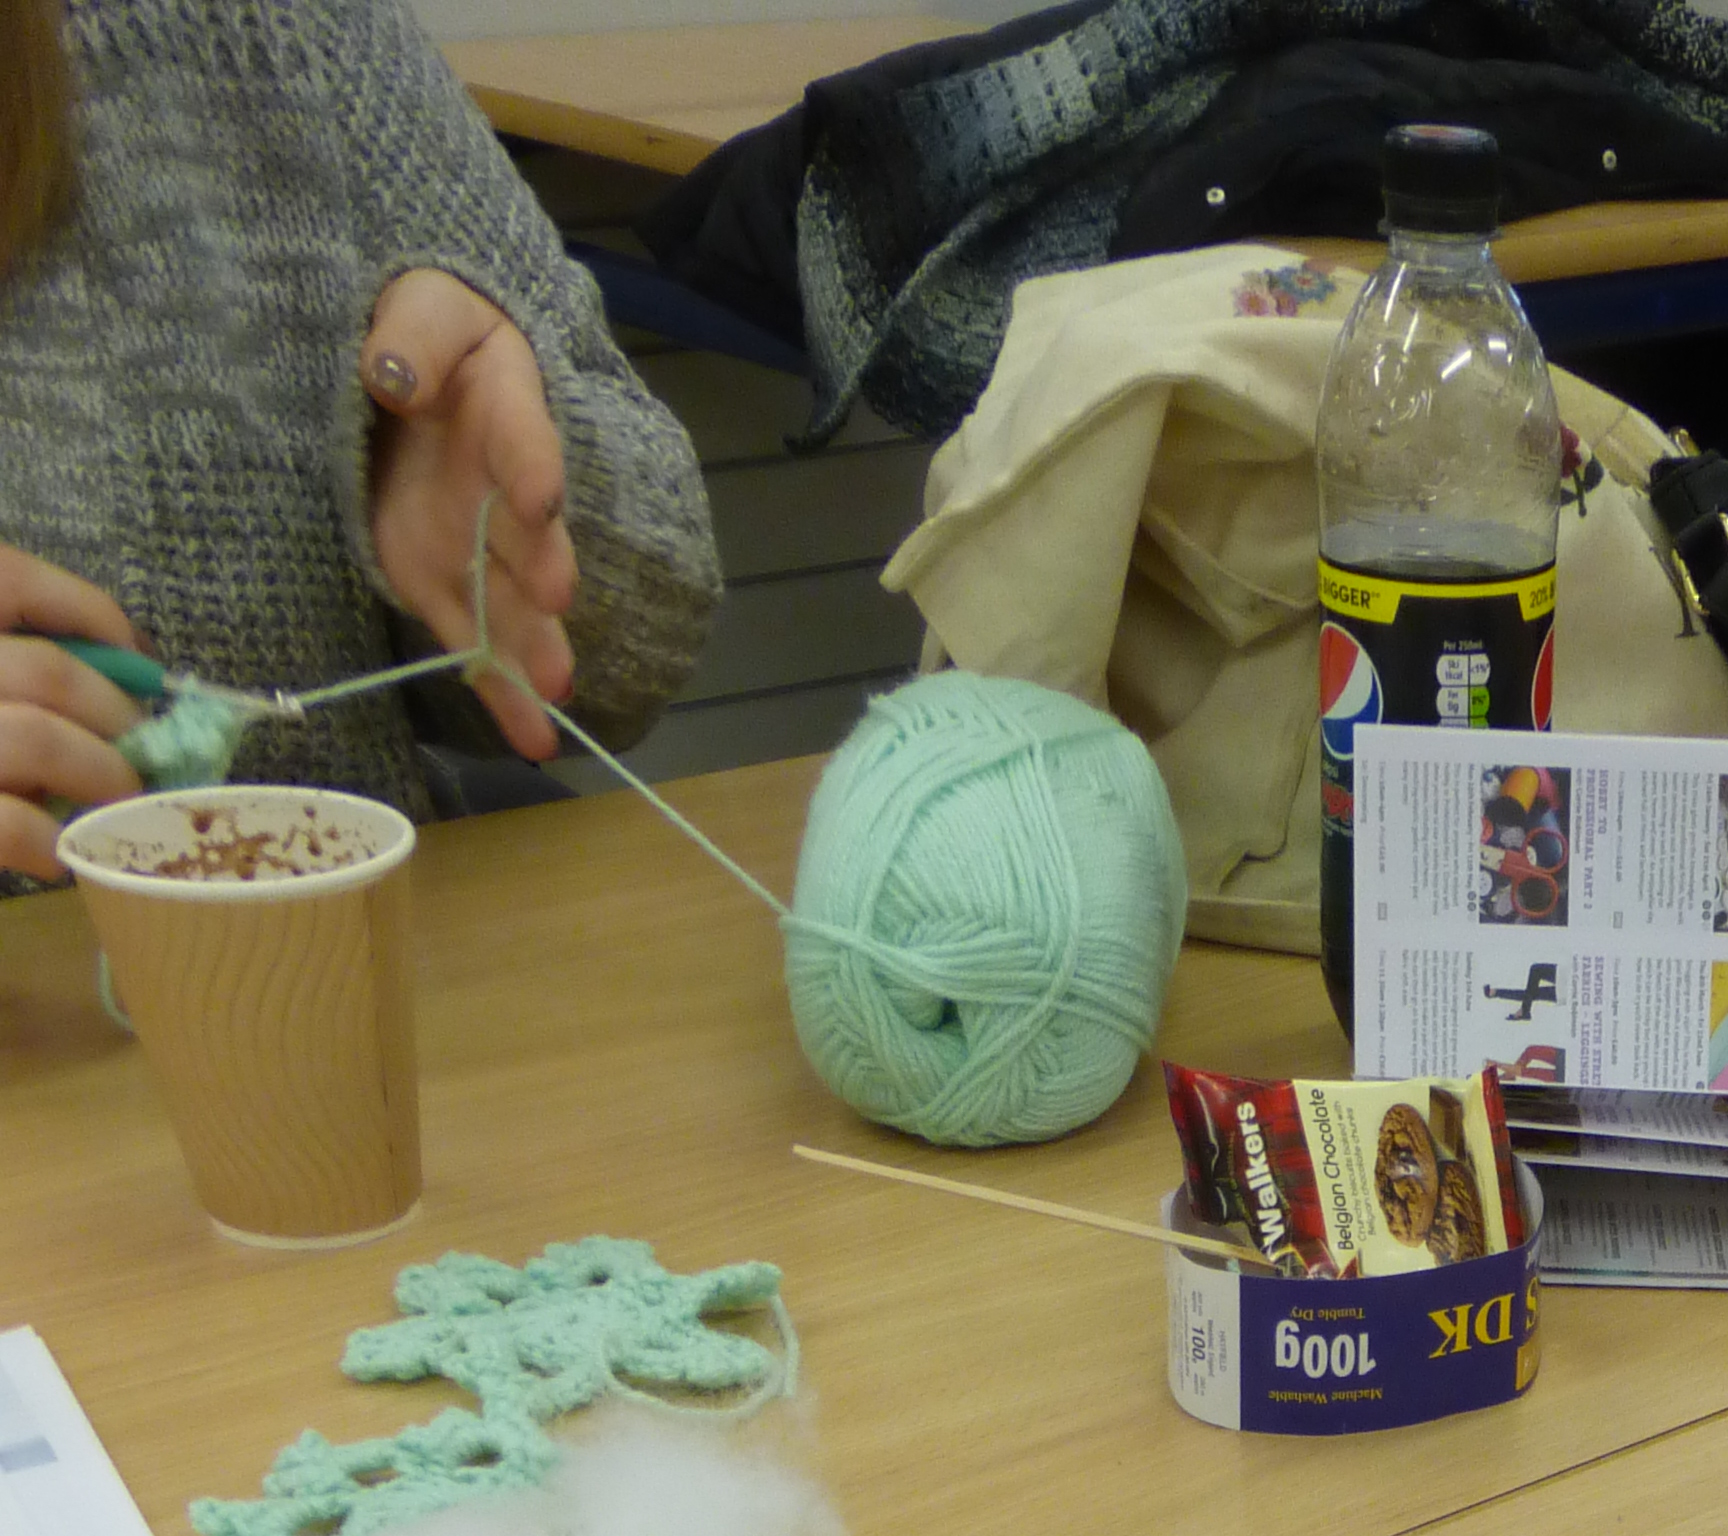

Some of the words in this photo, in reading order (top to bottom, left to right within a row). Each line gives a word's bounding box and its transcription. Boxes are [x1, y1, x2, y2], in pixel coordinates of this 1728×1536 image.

[1323, 584, 1371, 610] BIGGER
[1308, 1087, 1340, 1179] Chocolate
[1345, 1106, 1360, 1144] chunks
[1237, 1100, 1284, 1265] Walkers
[1352, 1144, 1370, 1196] chocolate
[1330, 1182, 1354, 1250] Belgian
[1350, 1198, 1367, 1242] Crunchy
[1361, 1196, 1377, 1236] Belgian
[1288, 1305, 1314, 1322] Dry
[1317, 1306, 1365, 1321] Tumble
[1428, 1293, 1516, 1360] DK
[1272, 1314, 1377, 1380] 100g
[1267, 1387, 1327, 1407] Washable
[1331, 1387, 1383, 1403] Machine
